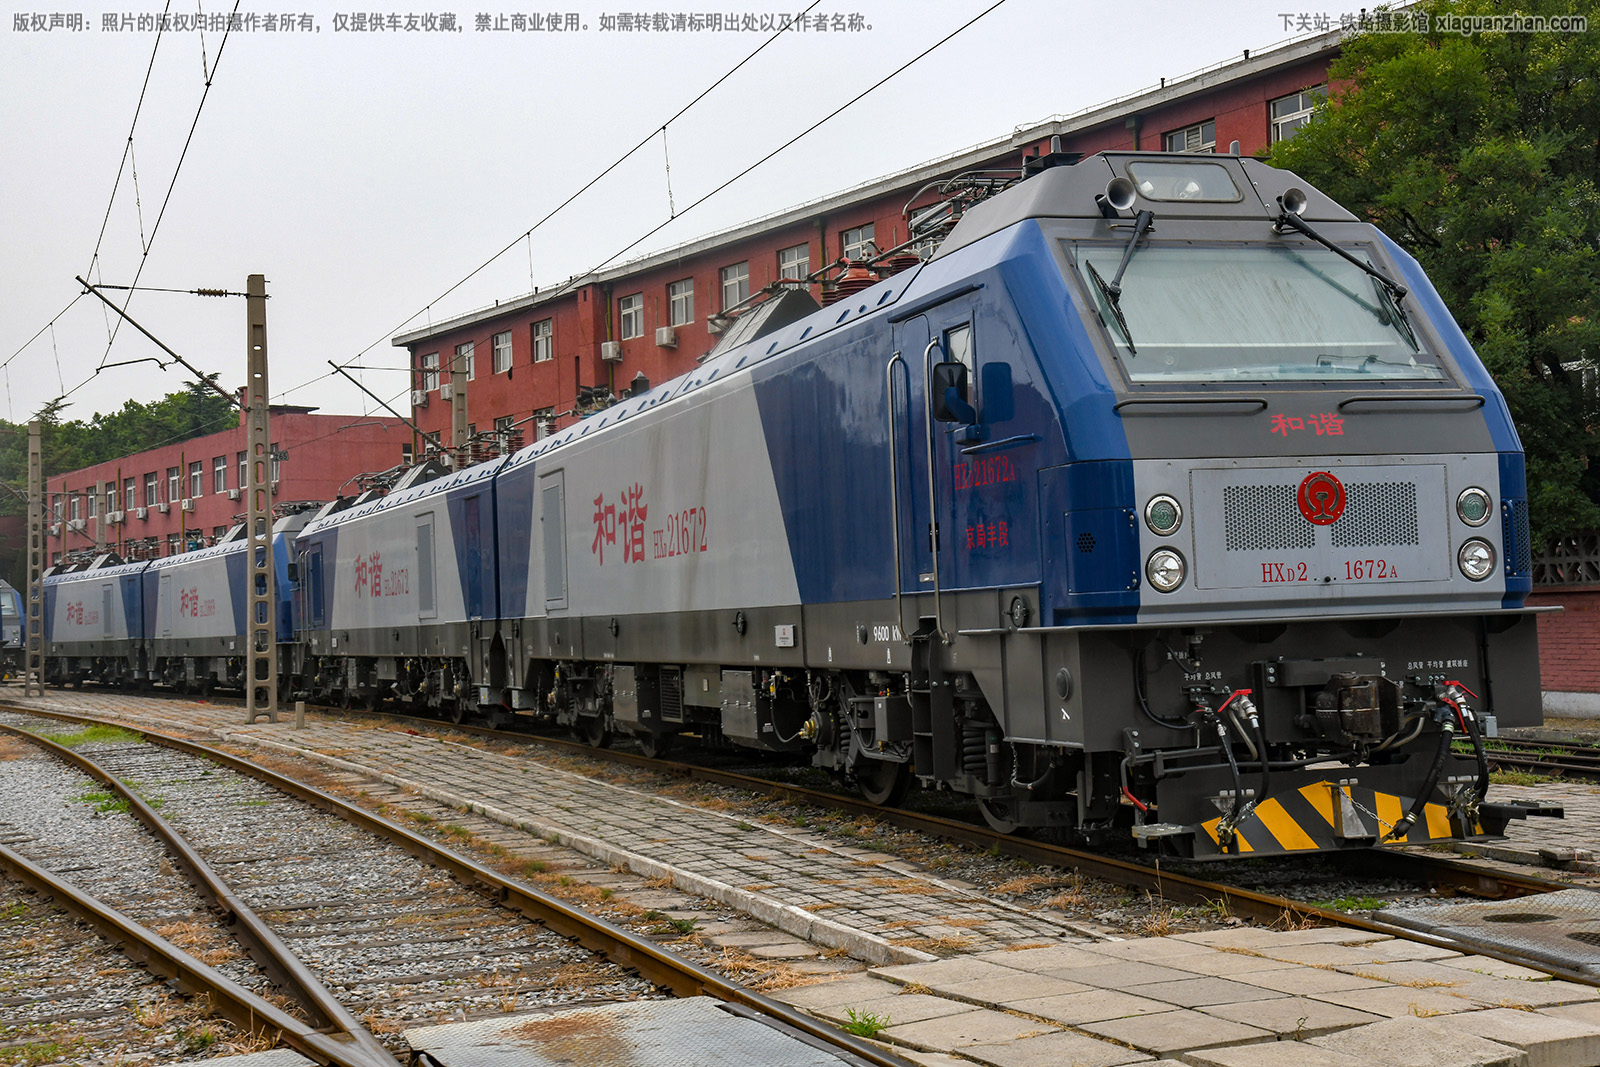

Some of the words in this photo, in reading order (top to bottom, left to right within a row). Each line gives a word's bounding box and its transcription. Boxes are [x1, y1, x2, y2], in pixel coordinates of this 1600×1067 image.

[1270, 412, 1345, 437] 和谐
[592, 481, 648, 567] 和谐
[965, 521, 1009, 550] 京局丰段
[355, 550, 383, 599] 和谐
[1261, 562, 1308, 583] HXD2
[1344, 559, 1398, 580] 1672A
[873, 625, 890, 641] 9600
